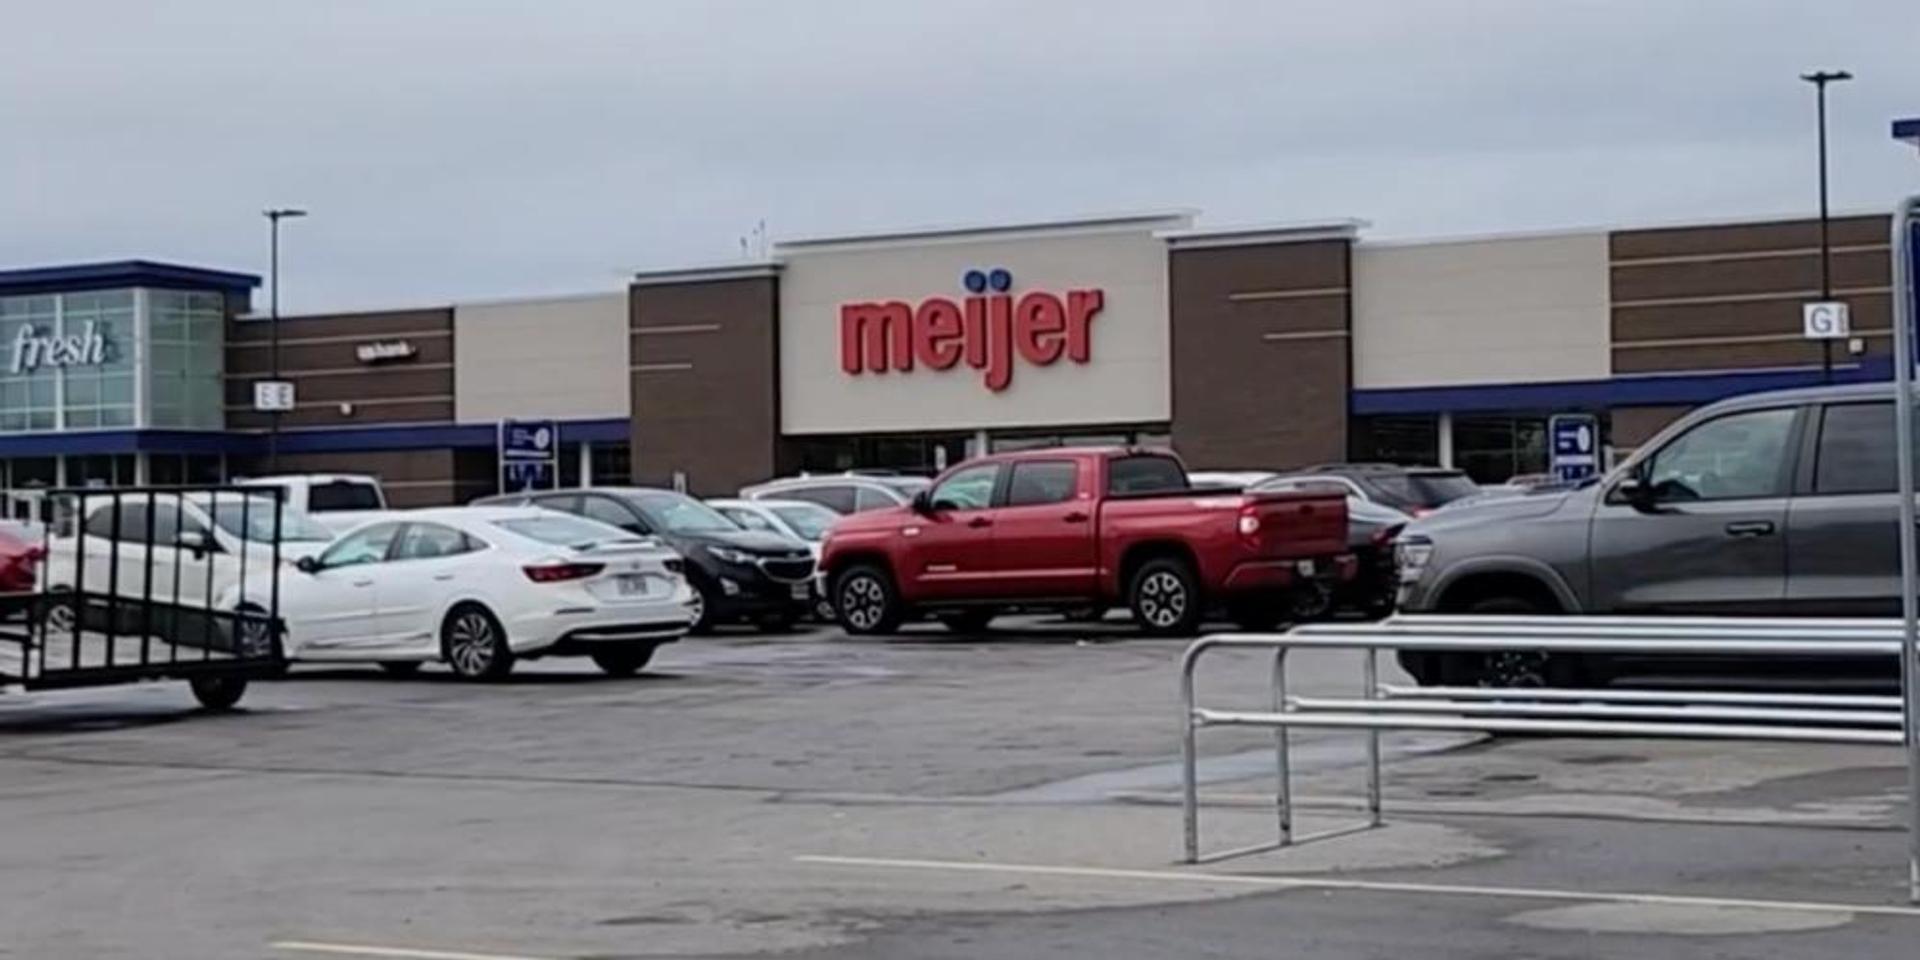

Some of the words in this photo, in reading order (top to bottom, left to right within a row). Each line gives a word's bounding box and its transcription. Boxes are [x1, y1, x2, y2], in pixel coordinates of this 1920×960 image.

[10, 320, 104, 374] fresh
[841, 269, 1104, 392] meijer
[1810, 306, 1832, 334] G
